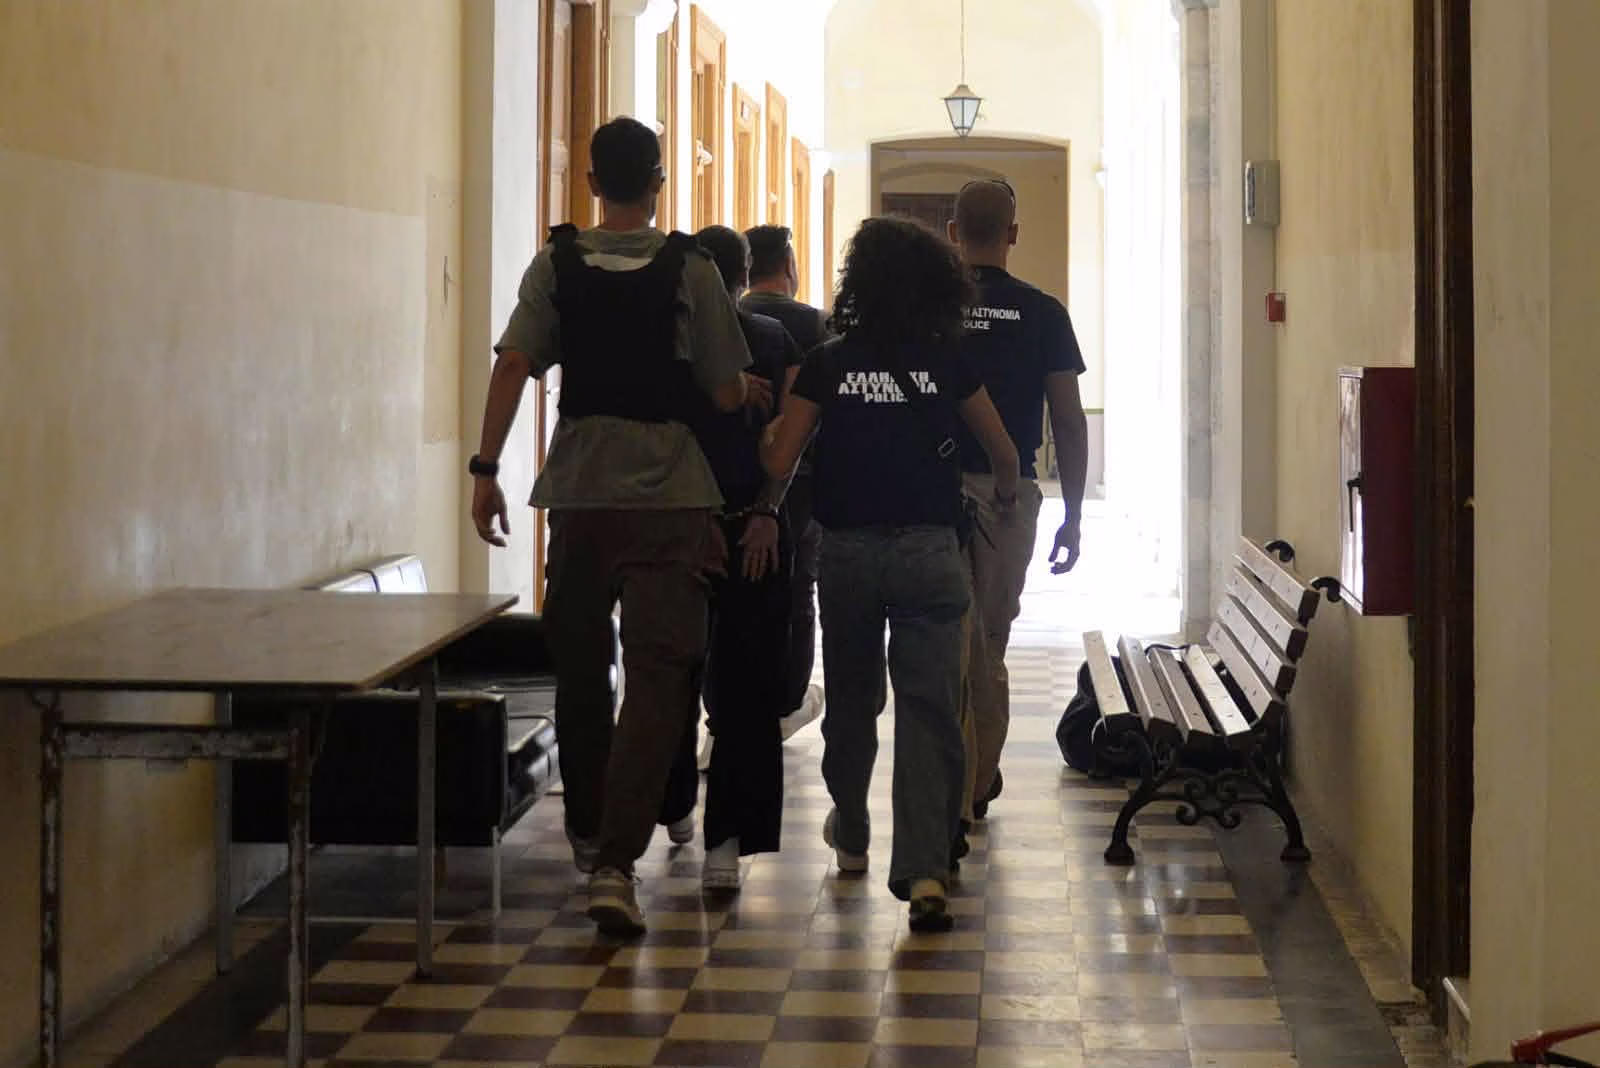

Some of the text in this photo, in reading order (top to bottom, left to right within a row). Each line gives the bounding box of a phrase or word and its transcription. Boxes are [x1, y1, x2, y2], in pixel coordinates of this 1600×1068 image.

[962, 319, 991, 330] OLICE
[837, 381, 938, 395] ΑΣΤΥΝΙΑ
[864, 392, 908, 403] POLIC
